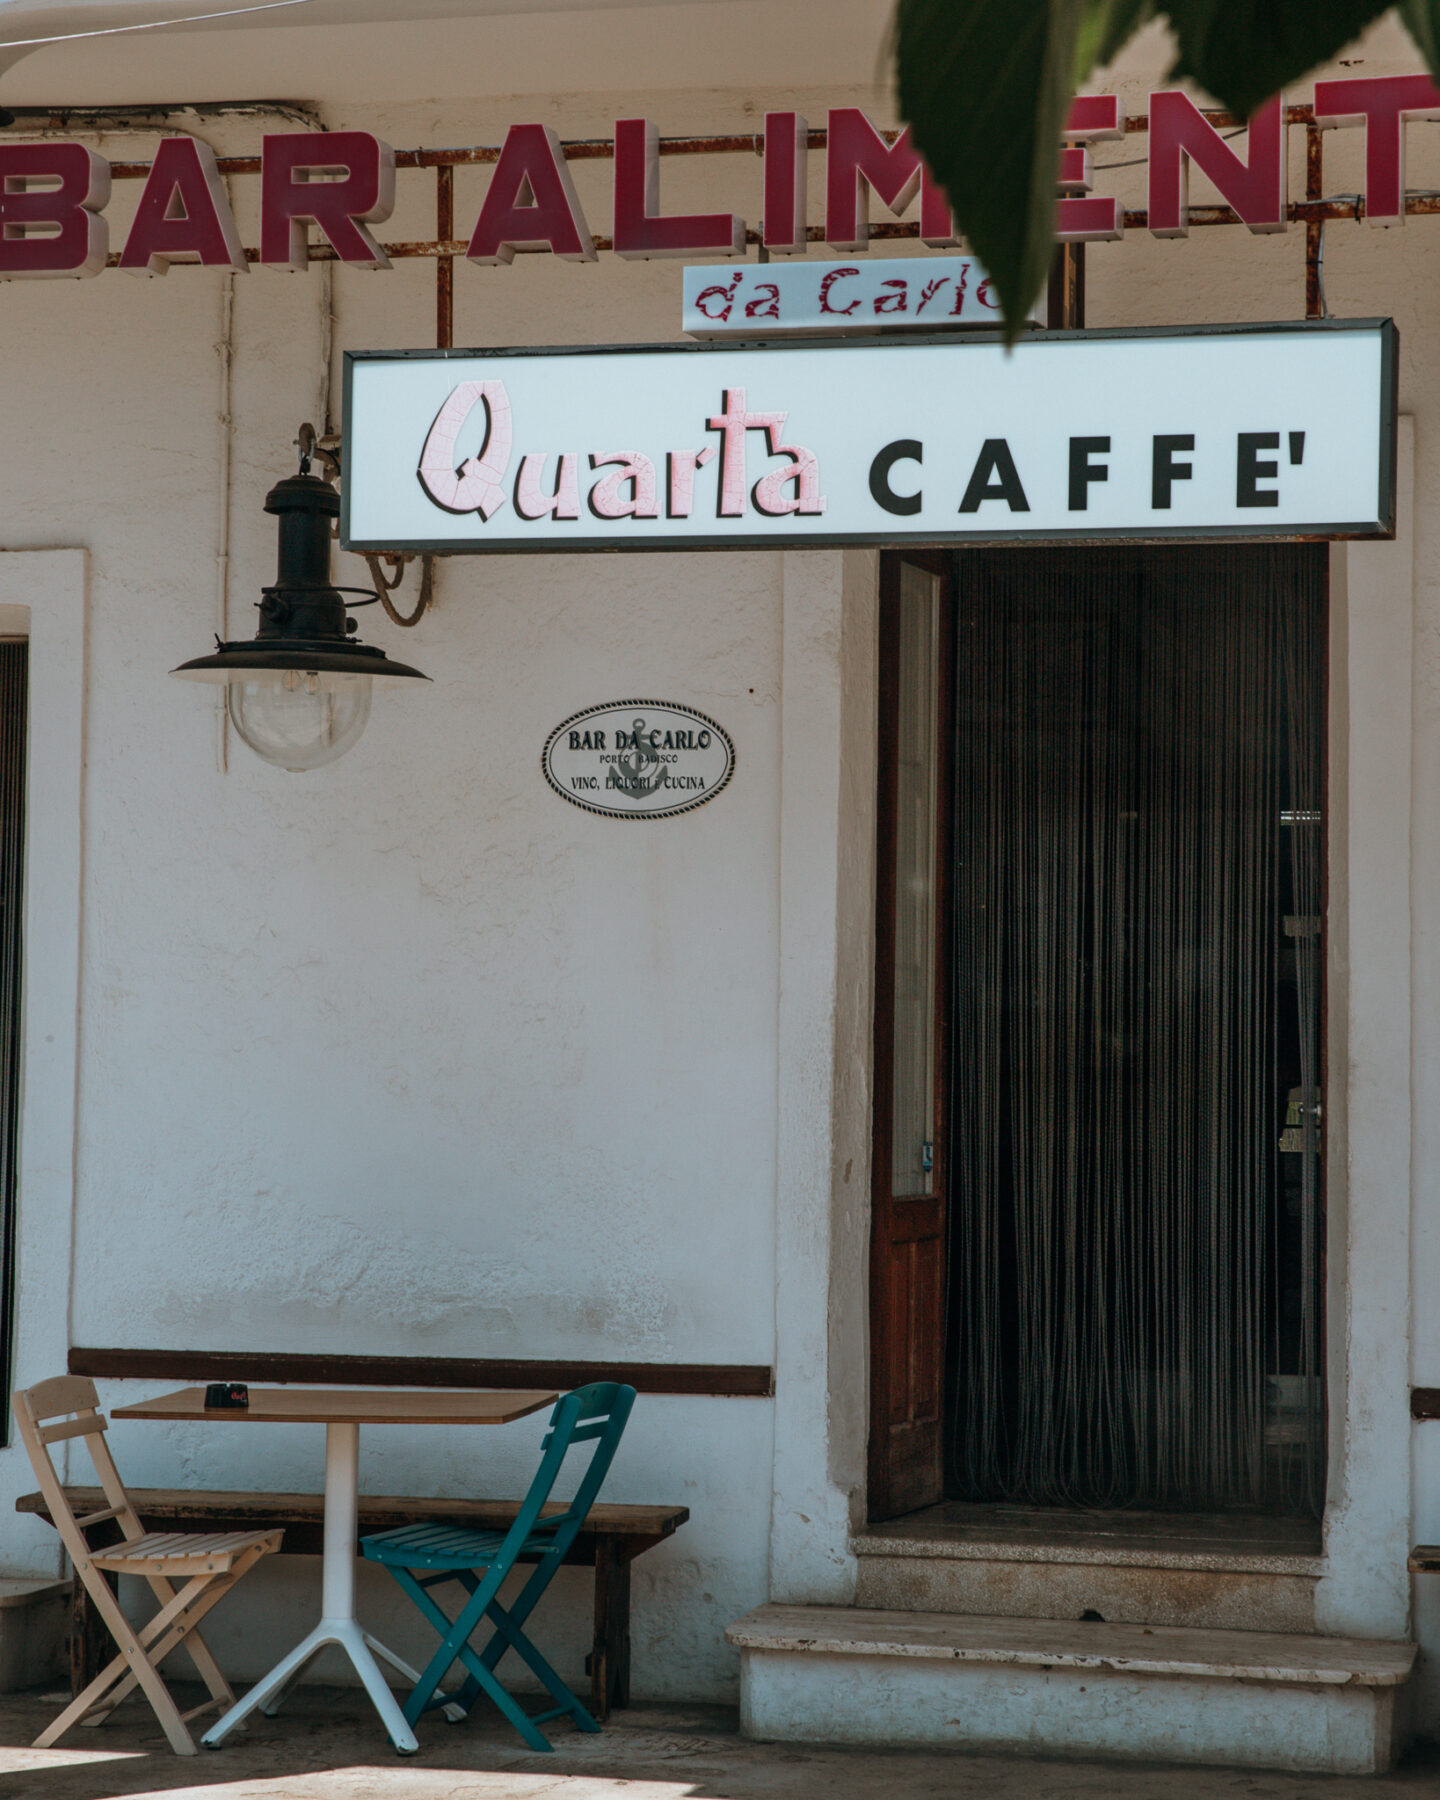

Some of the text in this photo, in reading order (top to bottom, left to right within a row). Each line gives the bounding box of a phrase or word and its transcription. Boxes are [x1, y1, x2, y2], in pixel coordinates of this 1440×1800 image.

[0, 131, 392, 276] BAR
[695, 272, 780, 322] da
[416, 379, 1306, 523] Quarta CAFFE'
[568, 729, 712, 751] BAR DA CARLO
[600, 754, 679, 764] PORTO BADISCO
[571, 776, 600, 791] VINO,
[605, 776, 650, 790] LIQUORI
[664, 776, 706, 790] CUCINA
